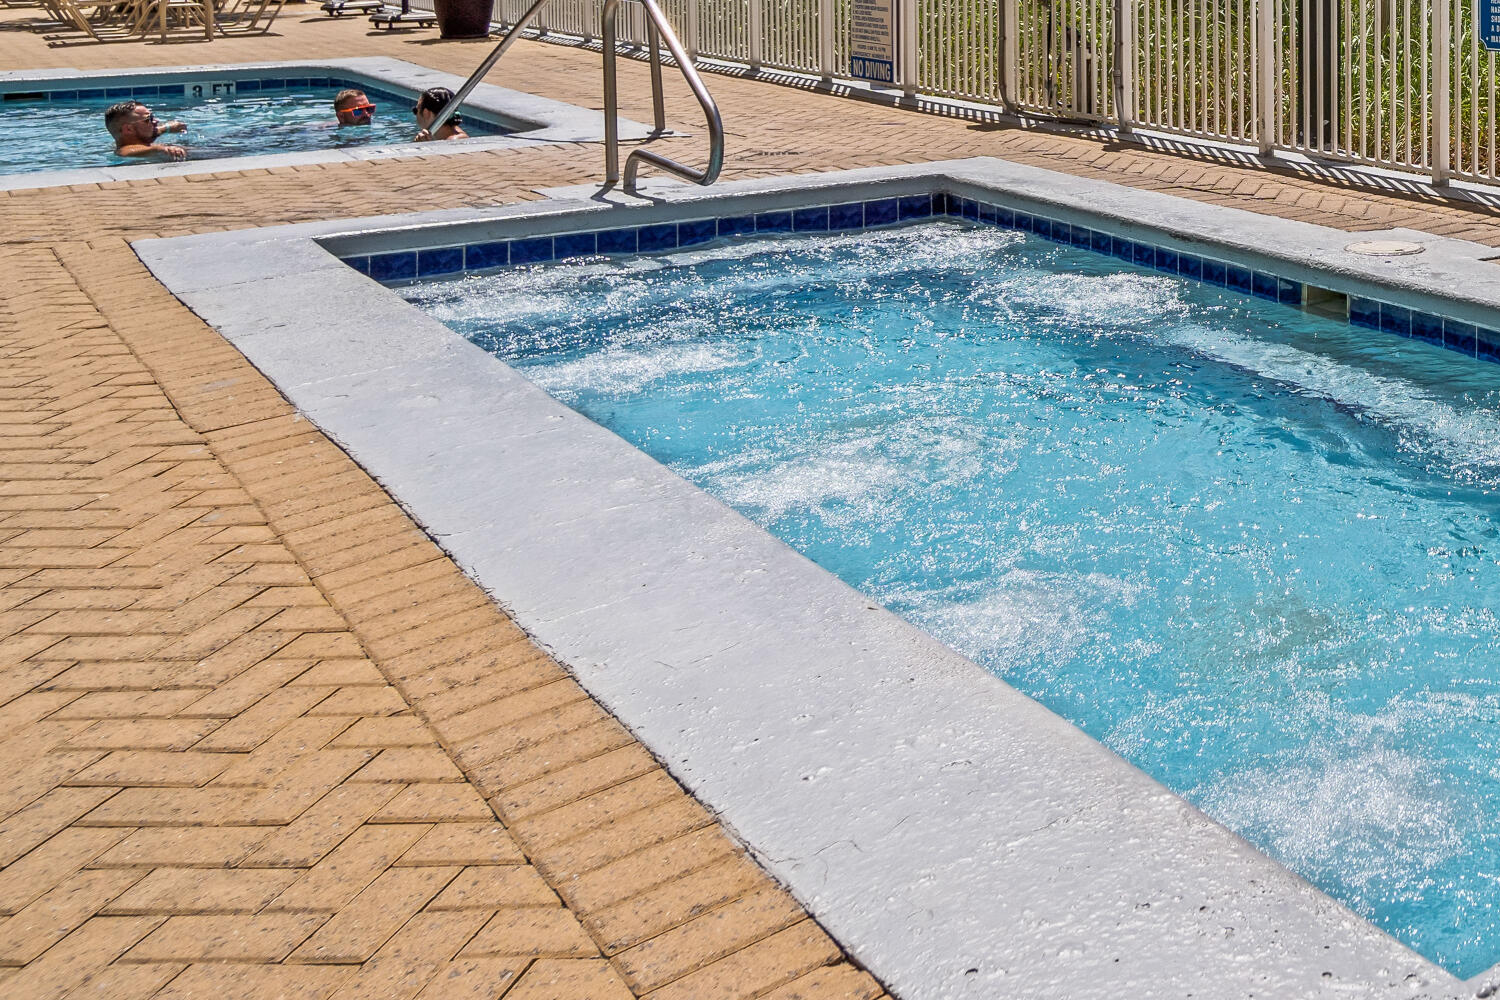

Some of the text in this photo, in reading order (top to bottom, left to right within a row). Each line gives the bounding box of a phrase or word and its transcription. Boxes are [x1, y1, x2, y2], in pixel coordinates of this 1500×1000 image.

[853, 59, 890, 80] NO DIVING
[212, 83, 233, 96] FT
